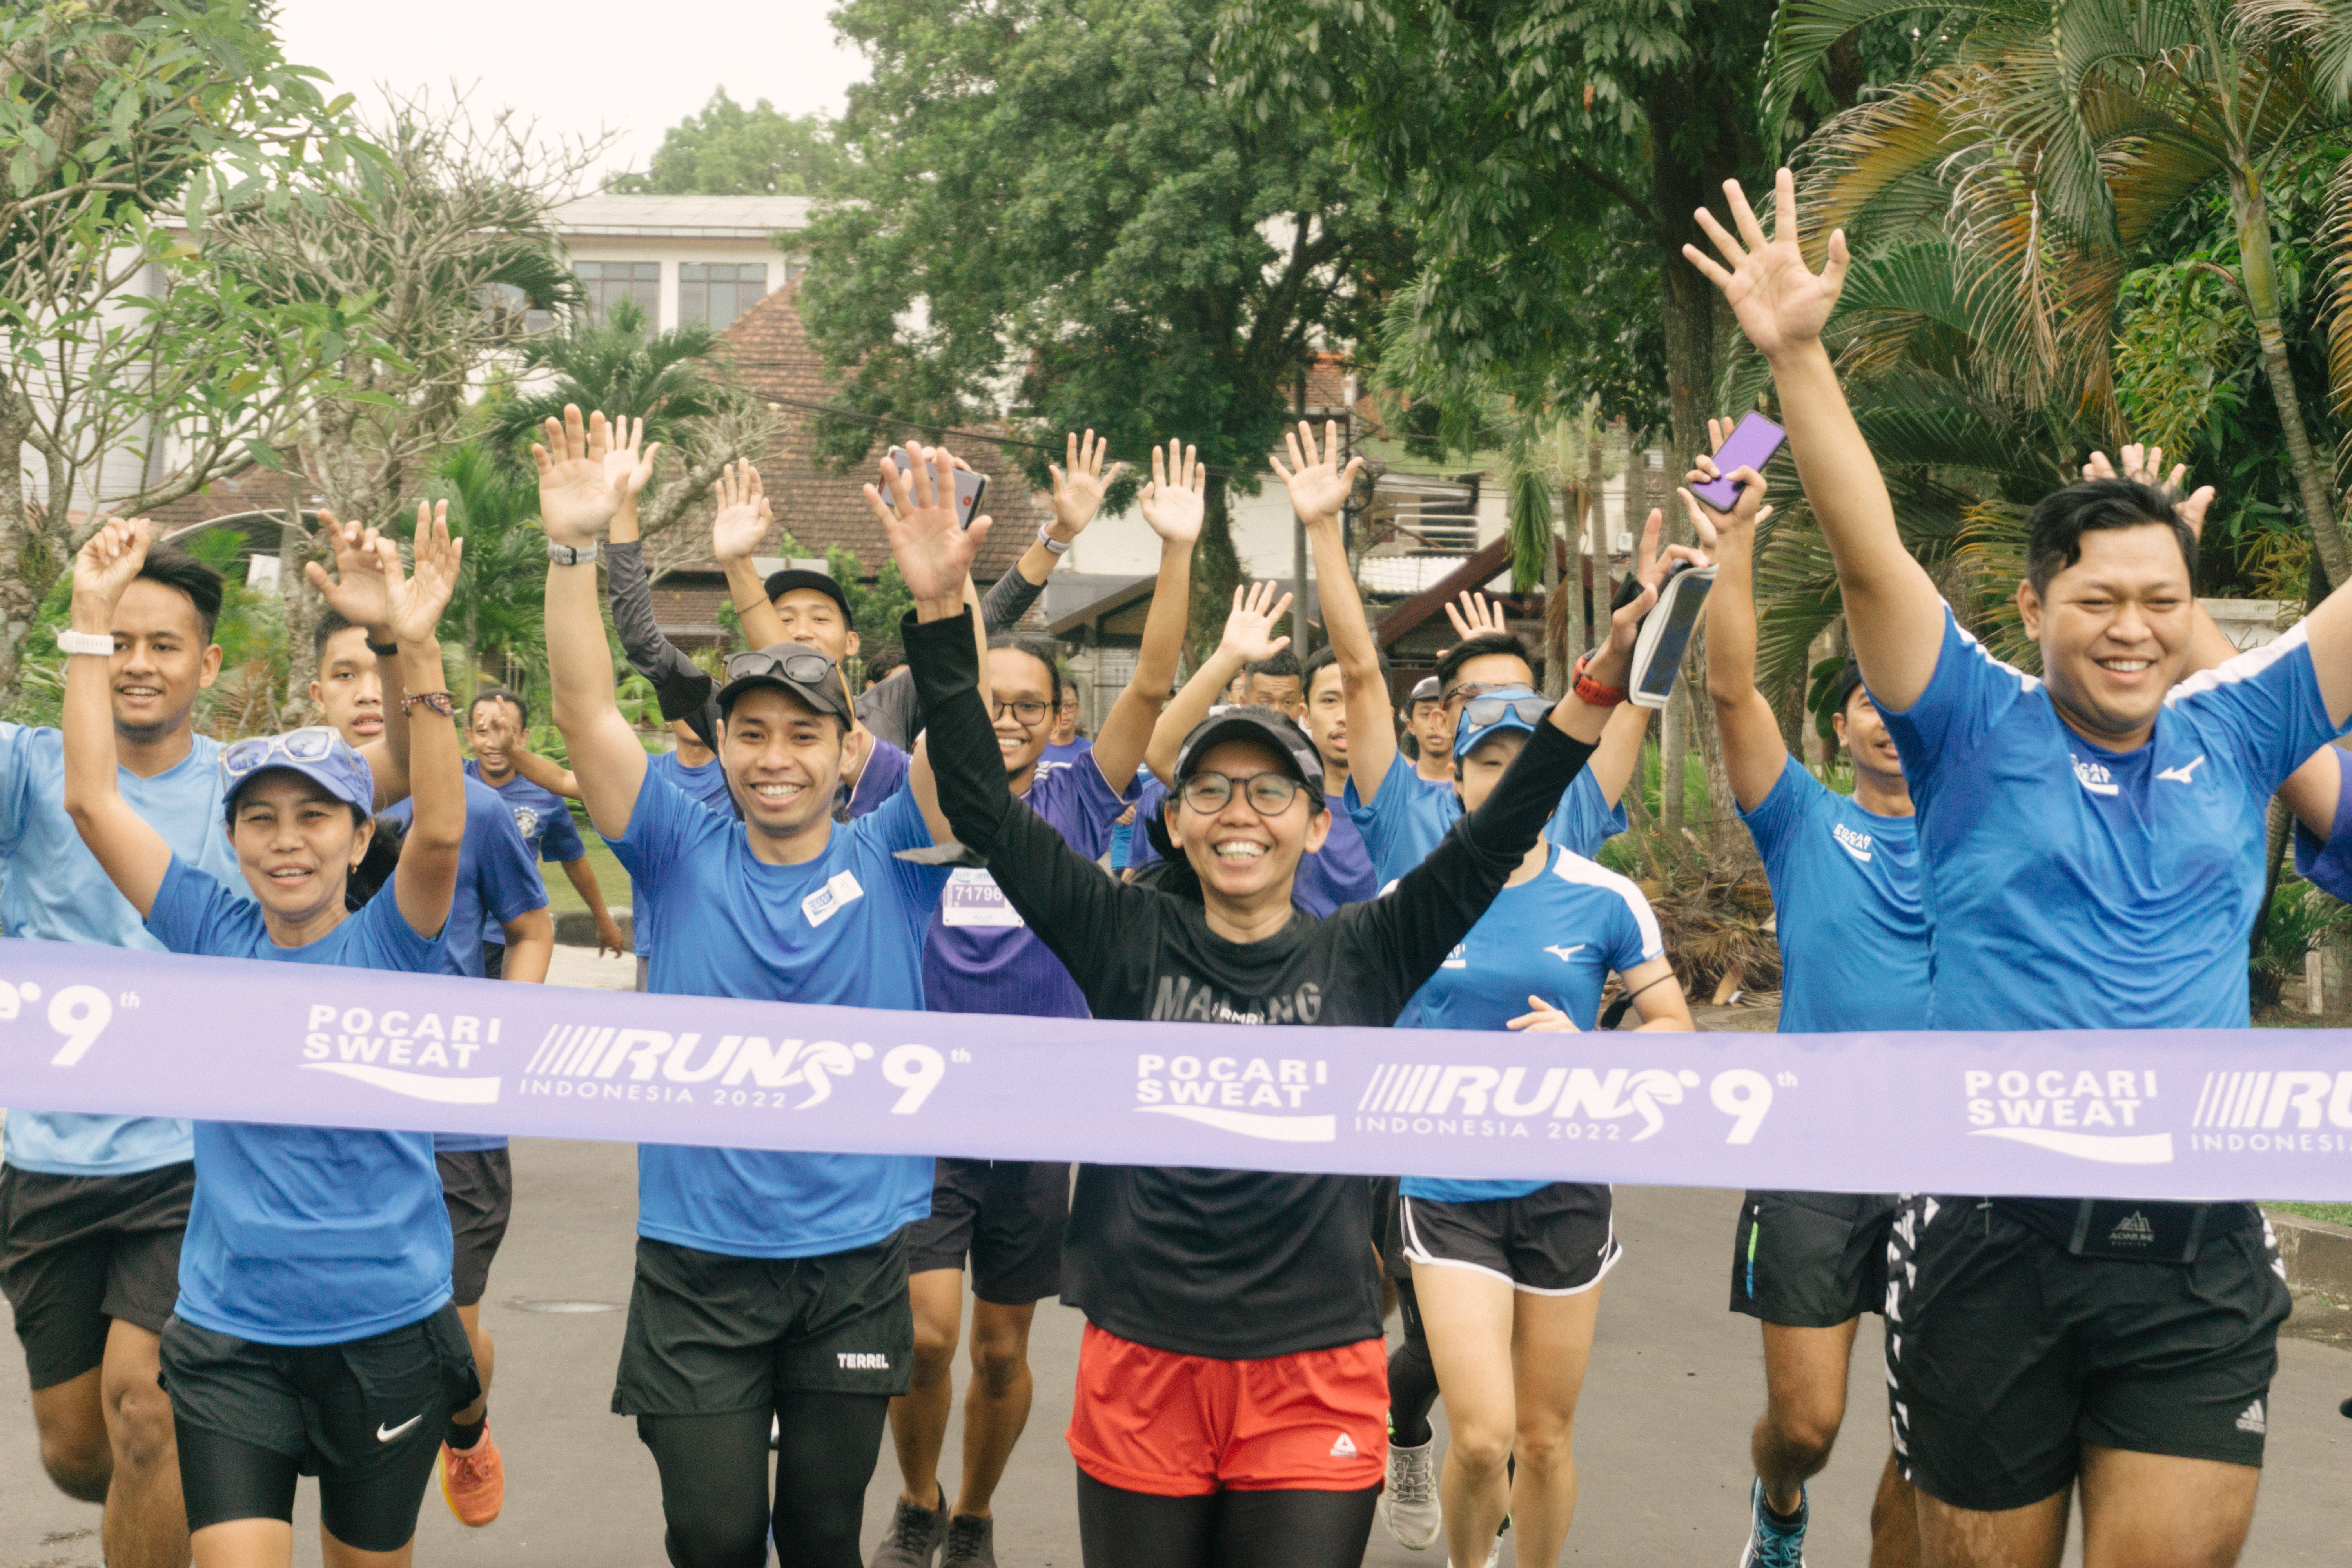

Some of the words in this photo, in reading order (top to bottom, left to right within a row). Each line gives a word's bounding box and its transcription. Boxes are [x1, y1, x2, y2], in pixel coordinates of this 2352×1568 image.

[955, 886, 1002, 901] 71796
[307, 1004, 501, 1044] POCARI
[303, 1032, 480, 1069] SWEAT
[1138, 1054, 1327, 1085] POCARI
[519, 1079, 693, 1103] INDONESIA
[713, 1089, 785, 1108] 2022
[1136, 1078, 1310, 1108] SWEAT
[1964, 1070, 2158, 1099] POCARI
[1967, 1098, 2141, 1127] SWEAT
[1356, 1117, 1528, 1136] INDONESIA
[1548, 1122, 1620, 1140] 2022
[2192, 1134, 2352, 1151] INDONESI
